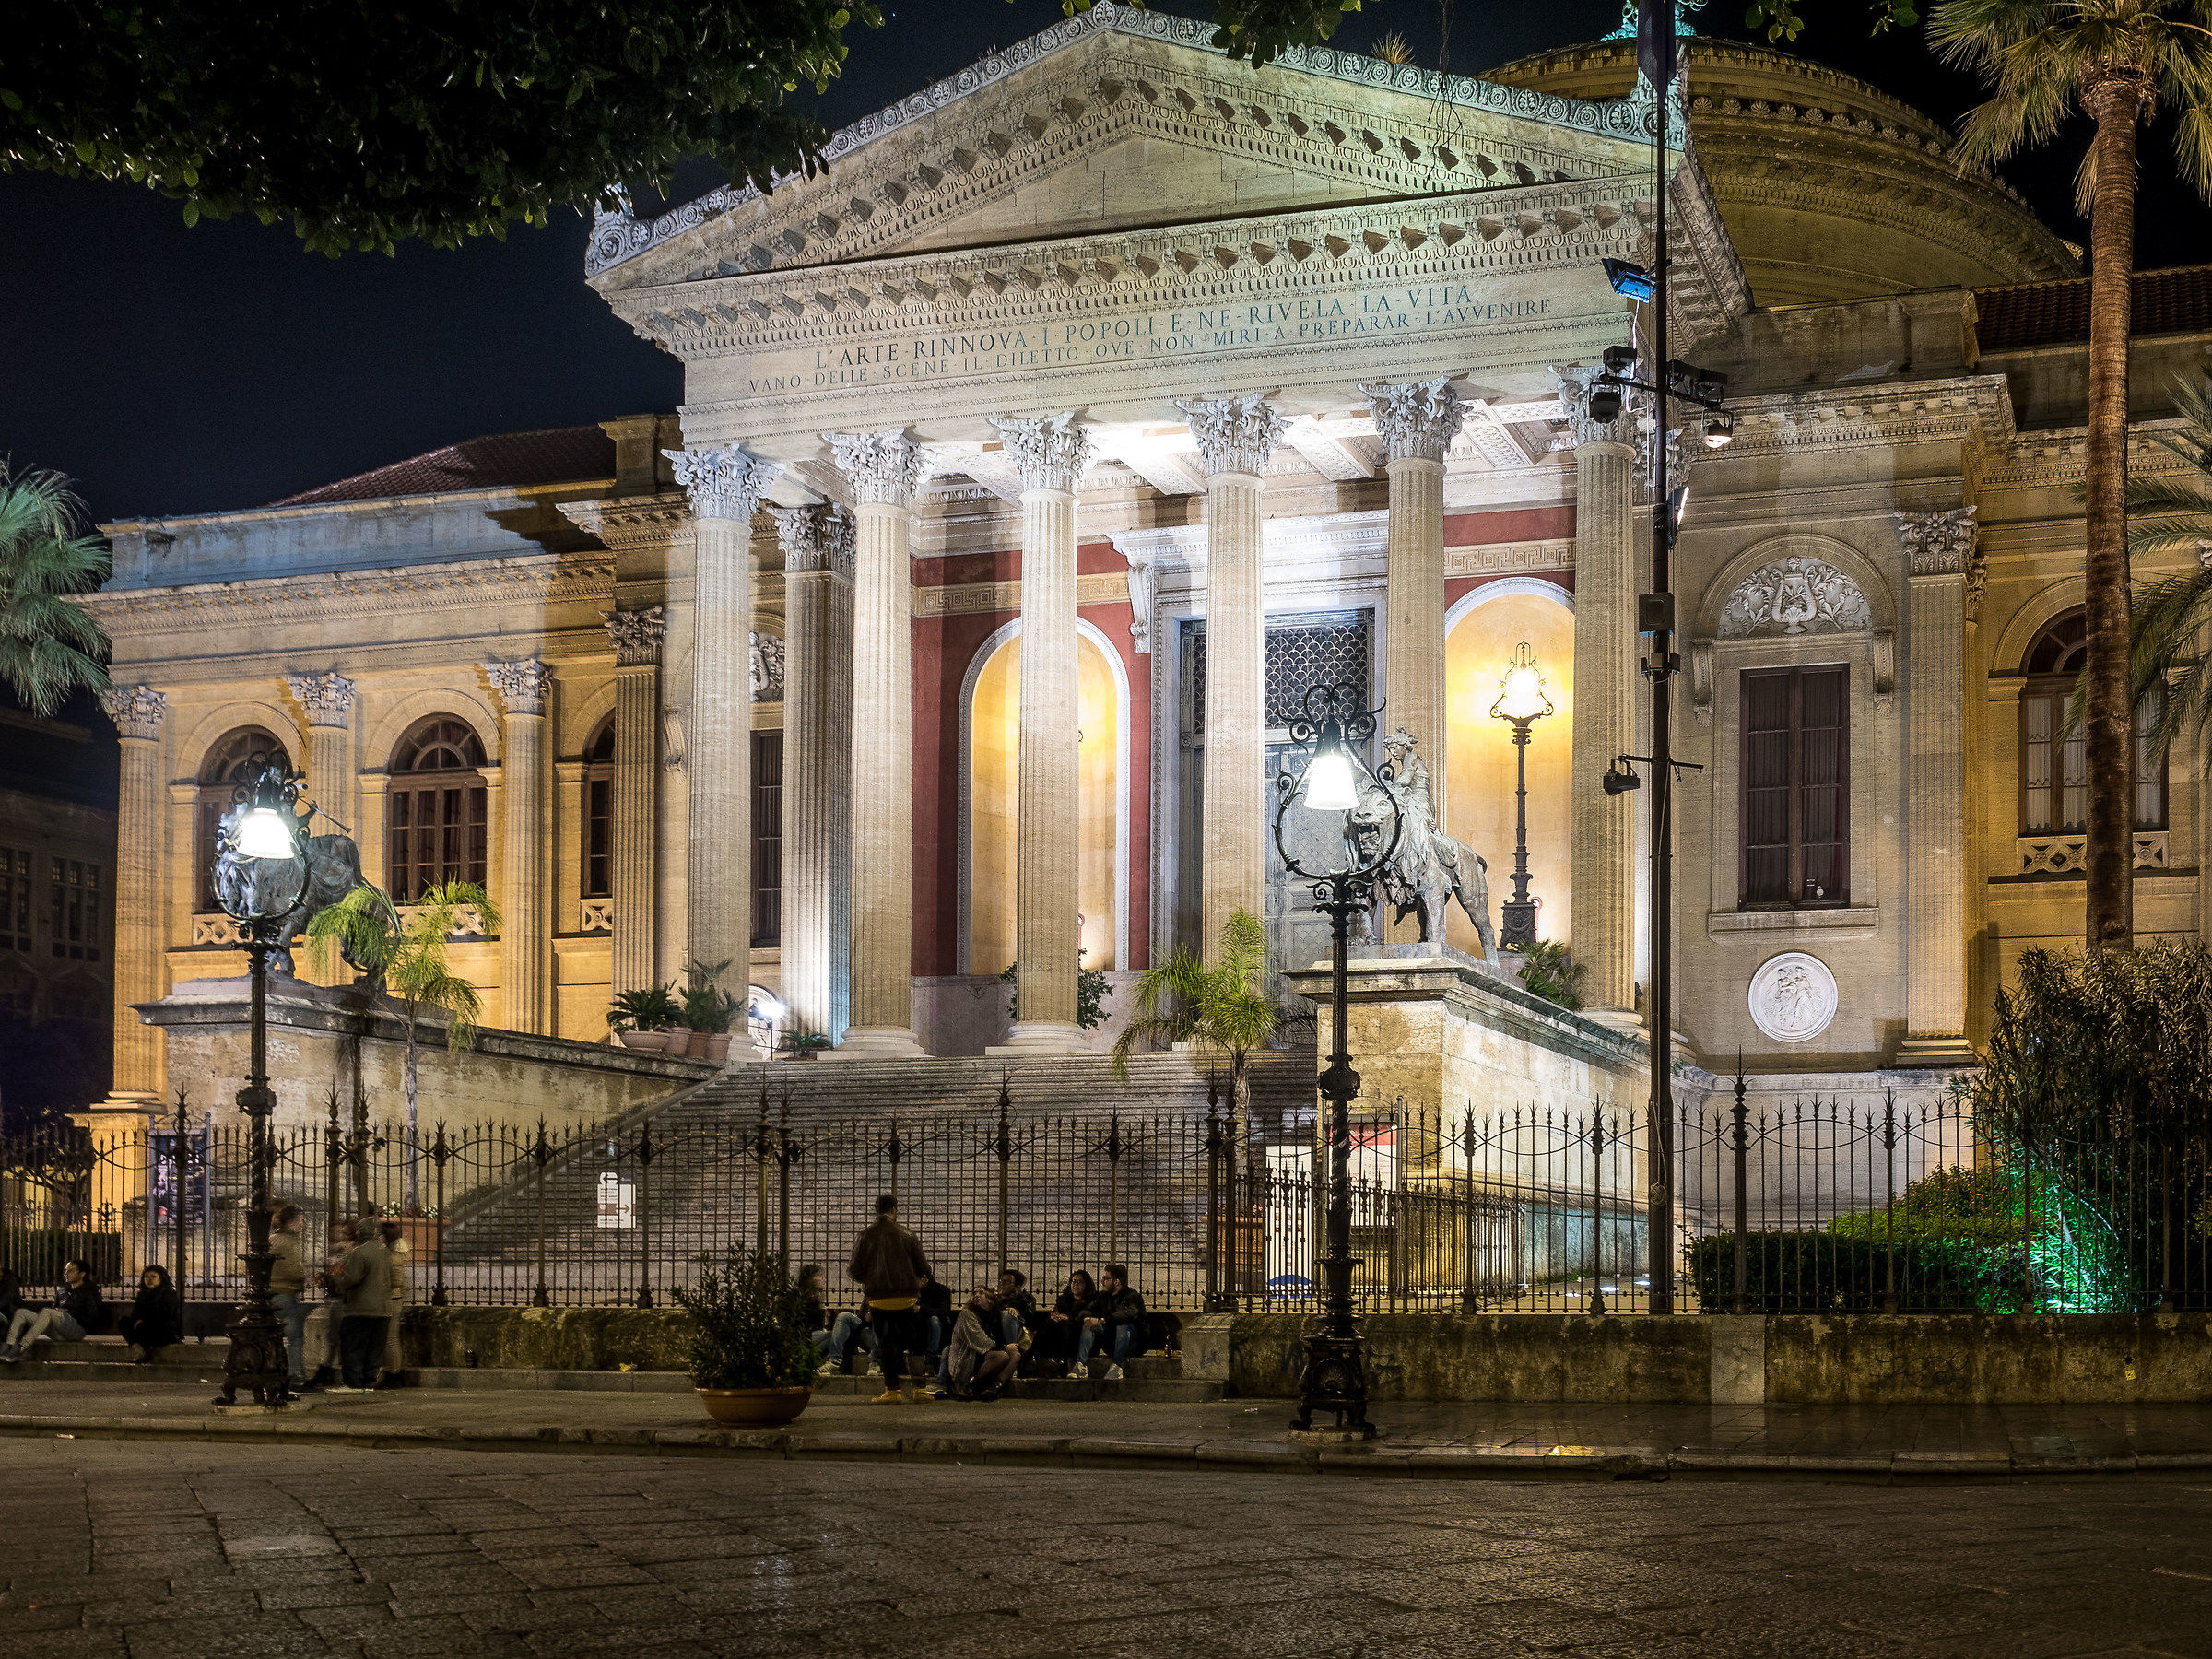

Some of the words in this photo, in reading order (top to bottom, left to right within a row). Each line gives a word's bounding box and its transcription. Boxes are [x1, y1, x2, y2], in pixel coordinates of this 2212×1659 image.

[749, 375, 801, 393] VANO
[814, 369, 868, 386] DELLE
[883, 359, 949, 380] SCENE
[964, 356, 982, 371] IL
[996, 347, 1078, 368] DILETTO
[1095, 340, 1135, 358] OVE
[1150, 334, 1194, 352] NON
[1214, 327, 1261, 347] MIRI
[1274, 326, 1286, 340] A
[1300, 313, 1410, 337] PREPARAR
[1426, 299, 1550, 325] L'AVVENIRE
[817, 344, 899, 370] L'ARTE
[913, 331, 1028, 359] RINNOVA
[1042, 327, 1049, 346] I
[1065, 316, 1154, 343] POPOLI
[1171, 313, 1182, 333] E
[1198, 309, 1231, 330] NE
[1249, 298, 1345, 325] RIVELA
[1363, 293, 1392, 313] LA
[1406, 285, 1472, 308] VITA
